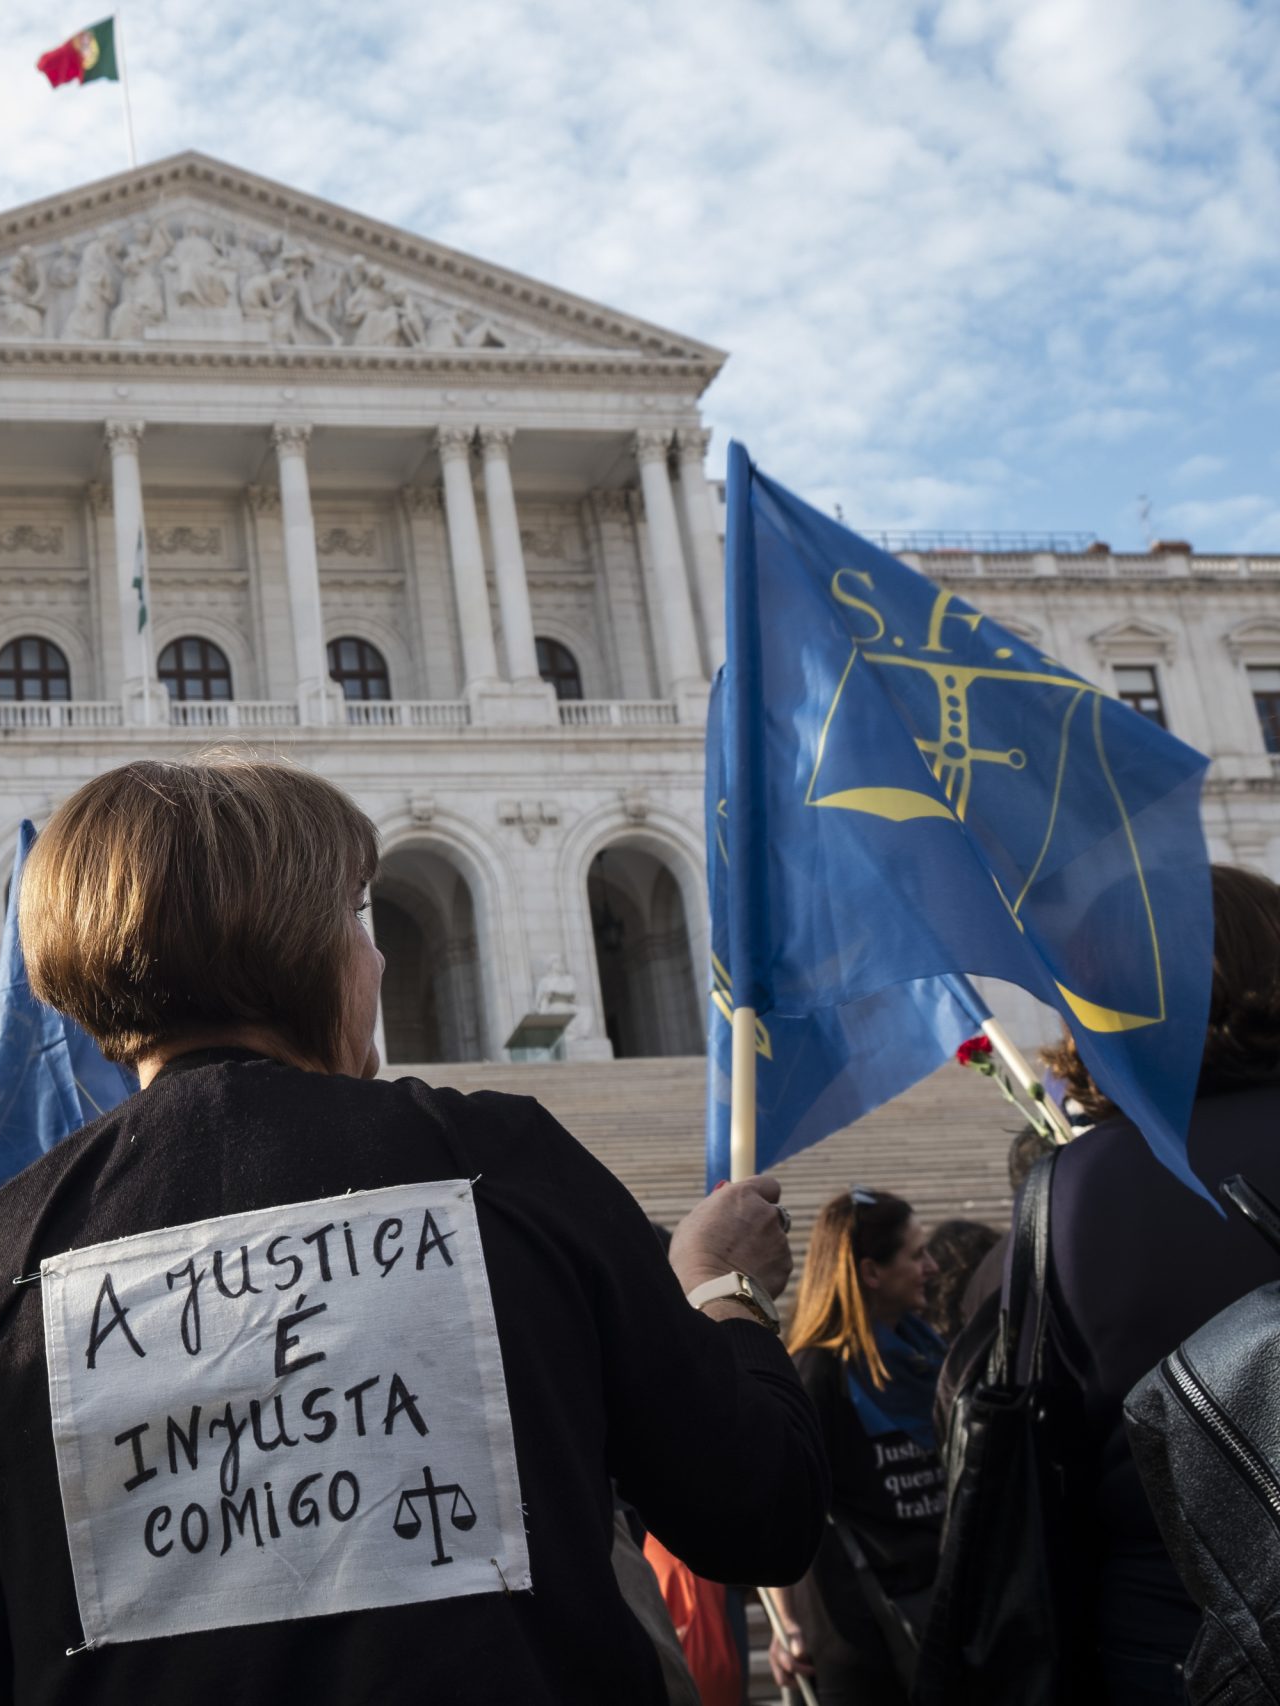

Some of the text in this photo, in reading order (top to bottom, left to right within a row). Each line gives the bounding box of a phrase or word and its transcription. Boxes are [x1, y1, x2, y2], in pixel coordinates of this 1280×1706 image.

[86, 1209, 457, 1369] A JUSTIÇA
[275, 1294, 327, 1378] É
[114, 1373, 429, 1496] INJUSTA
[144, 1470, 360, 1557] COMIGO
